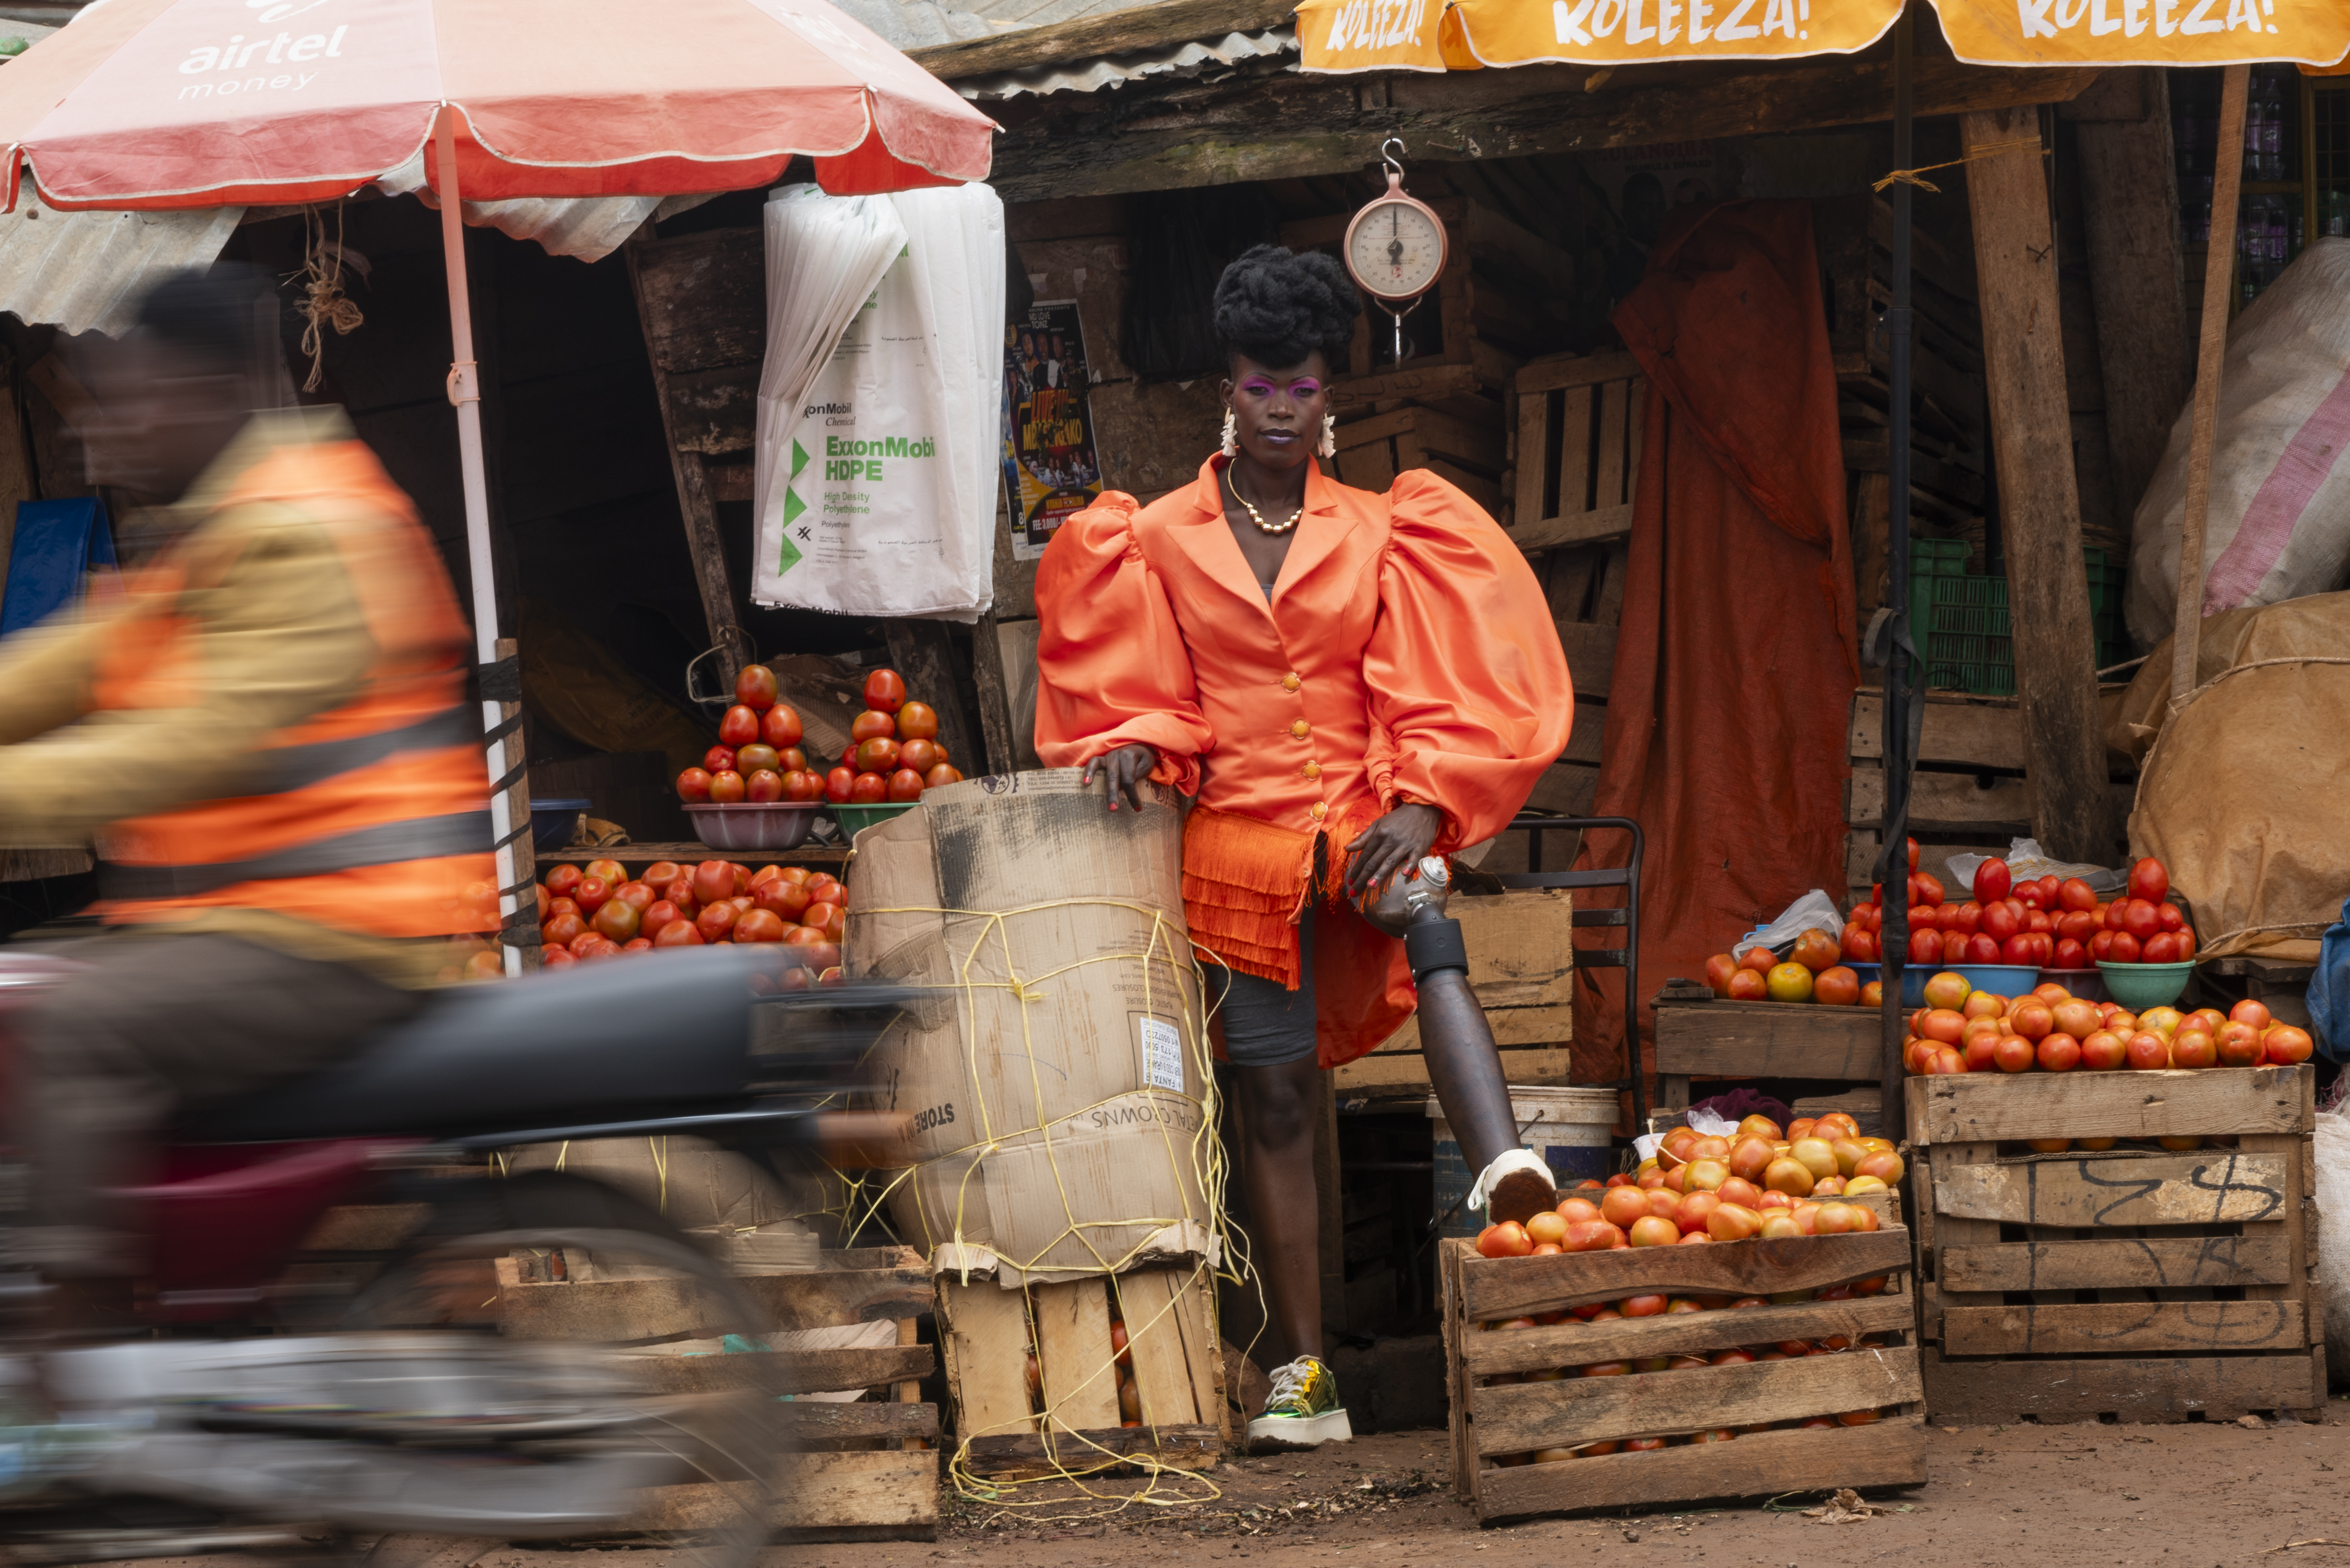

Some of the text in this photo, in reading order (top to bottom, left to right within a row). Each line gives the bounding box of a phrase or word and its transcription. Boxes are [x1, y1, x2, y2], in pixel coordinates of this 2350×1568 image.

[1326, 0, 1421, 51] KOLEEZA!
[178, 24, 349, 75] airtel
[177, 71, 319, 100] money
[1625, 160, 1712, 172] NDAWULA EDWARD
[803, 403, 852, 418] xonMobil
[825, 416, 856, 426] Chemical
[825, 459, 883, 481] HDPE
[824, 492, 870, 503] High Density
[823, 504, 870, 515] Polyethylene
[629, 707, 668, 736] IMITED
[1112, 984, 1145, 992] CLOSURES
[1149, 986, 1166, 995] EVIDEN
[1160, 1045, 1171, 1055] 173
[1154, 1074, 1175, 1088] FANTA
[914, 1103, 955, 1134] STORE
[1069, 1114, 1083, 1123] Ltd
[1091, 1105, 1170, 1128] CROWNS
[904, 1118, 915, 1141] IN
